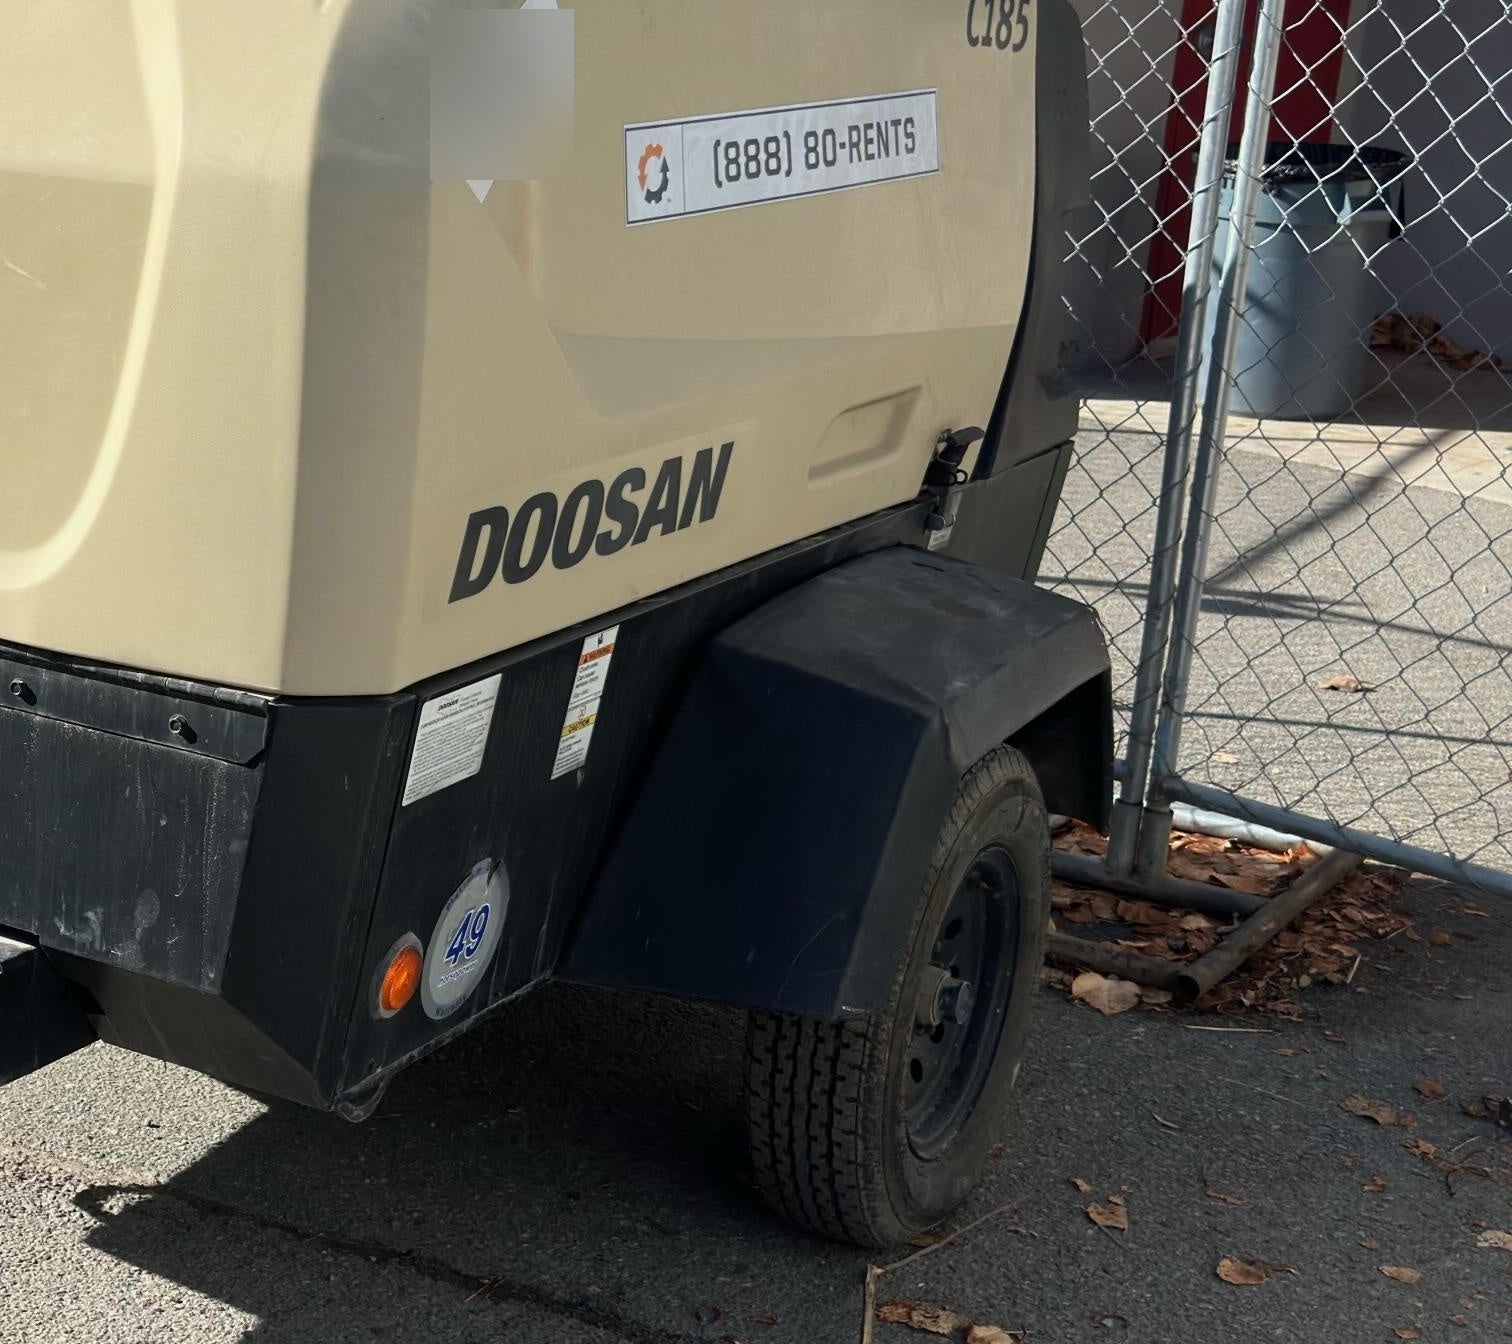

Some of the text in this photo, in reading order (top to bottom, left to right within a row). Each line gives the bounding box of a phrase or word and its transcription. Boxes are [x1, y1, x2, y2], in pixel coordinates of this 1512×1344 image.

[713, 116, 916, 188] (888) 80-RENTS
[448, 441, 734, 604] DOOSAN
[444, 903, 491, 967] 49
